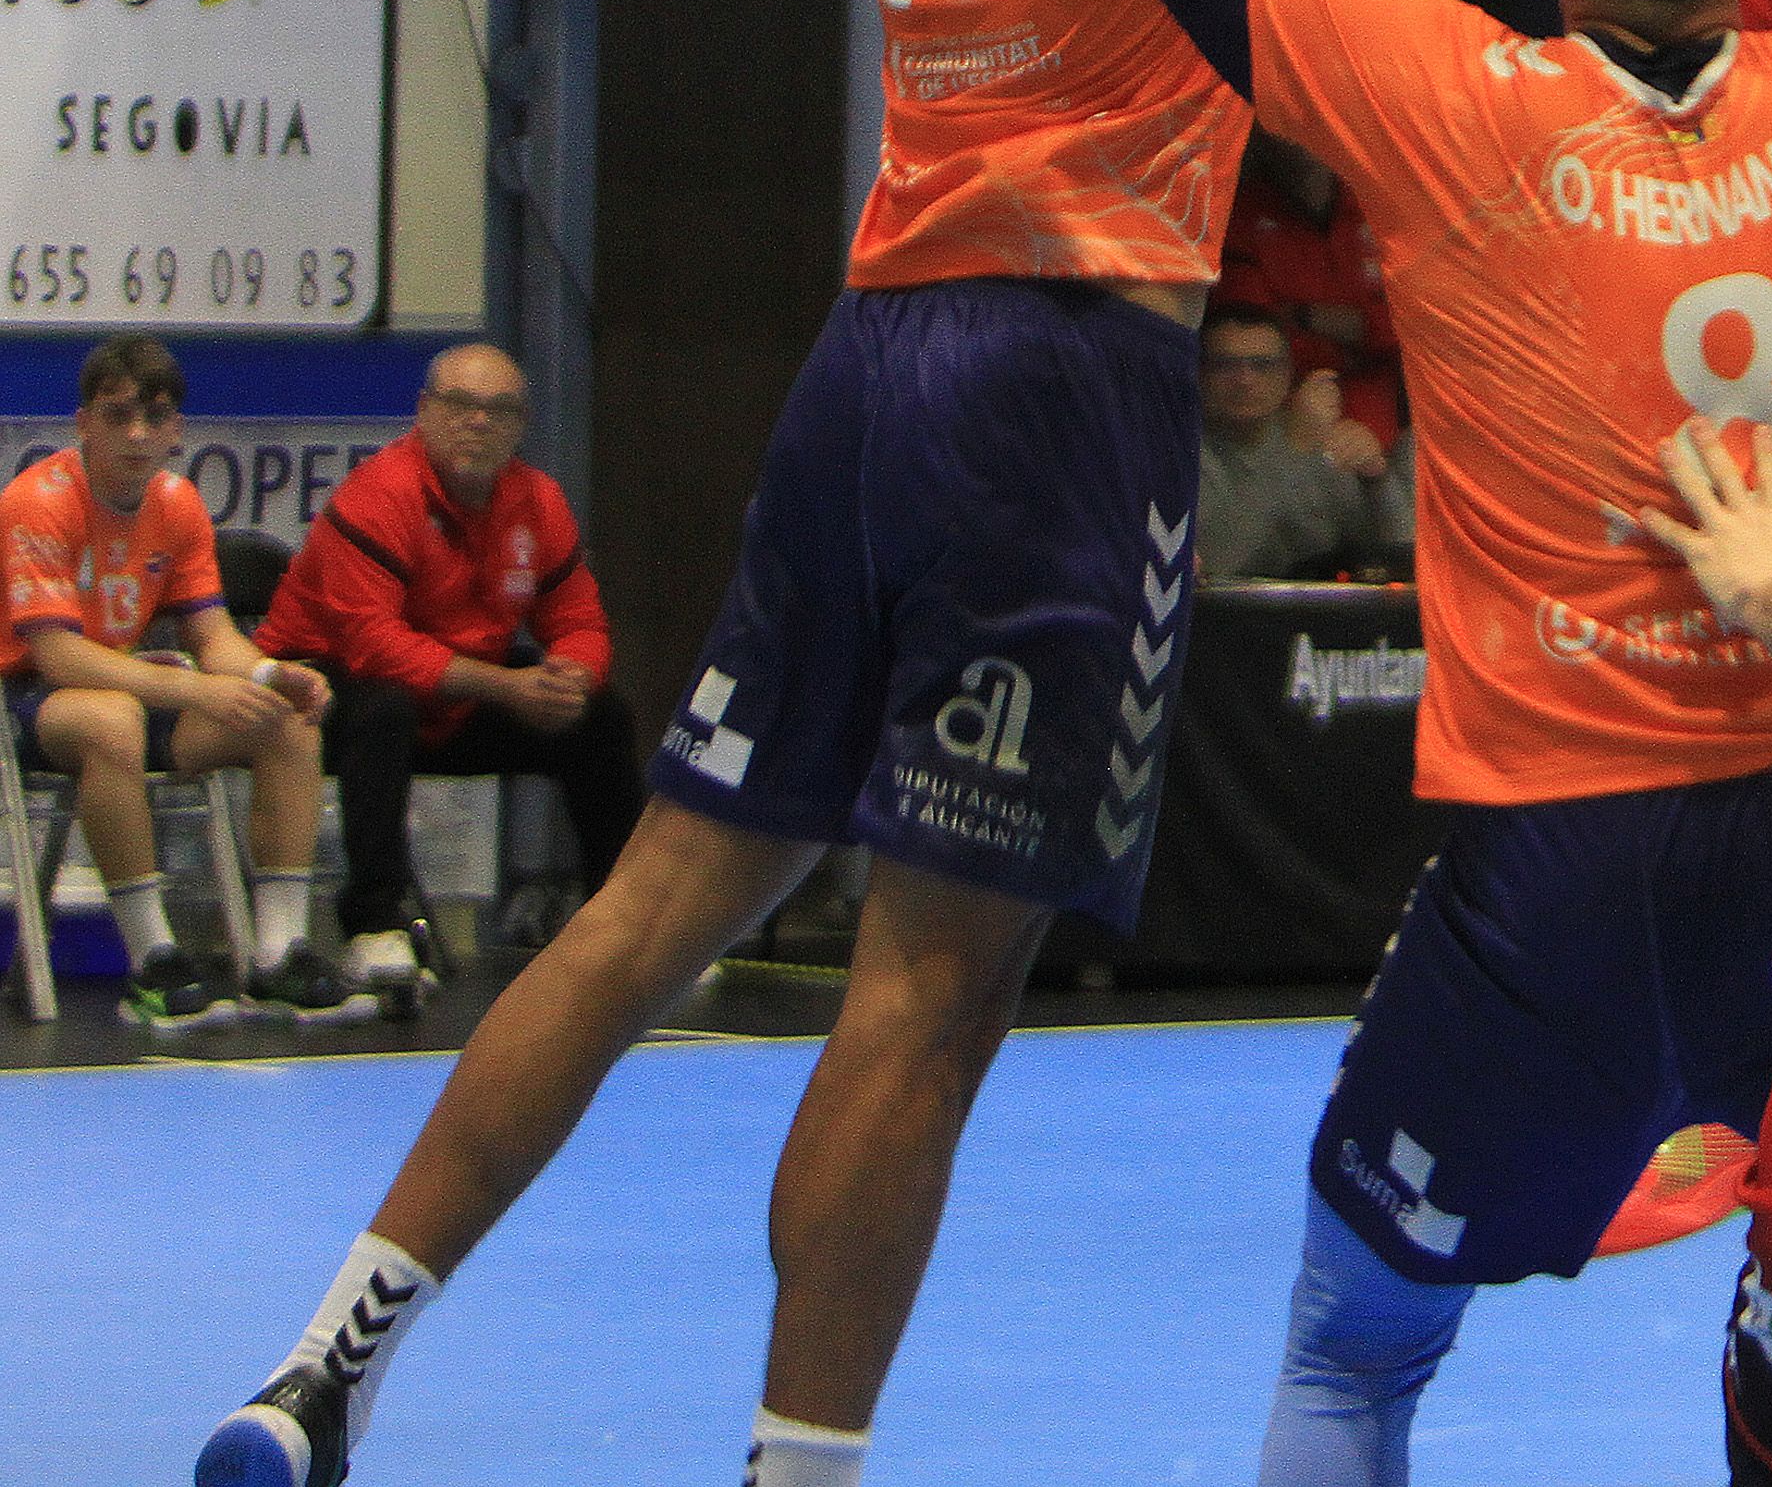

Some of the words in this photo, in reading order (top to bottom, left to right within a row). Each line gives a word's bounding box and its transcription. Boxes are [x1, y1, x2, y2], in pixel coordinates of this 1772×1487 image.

[56, 92, 312, 158] SEGOVIA
[8, 245, 90, 305] 655
[123, 246, 179, 307] 69
[210, 247, 264, 309] 09
[301, 248, 357, 309] 83
